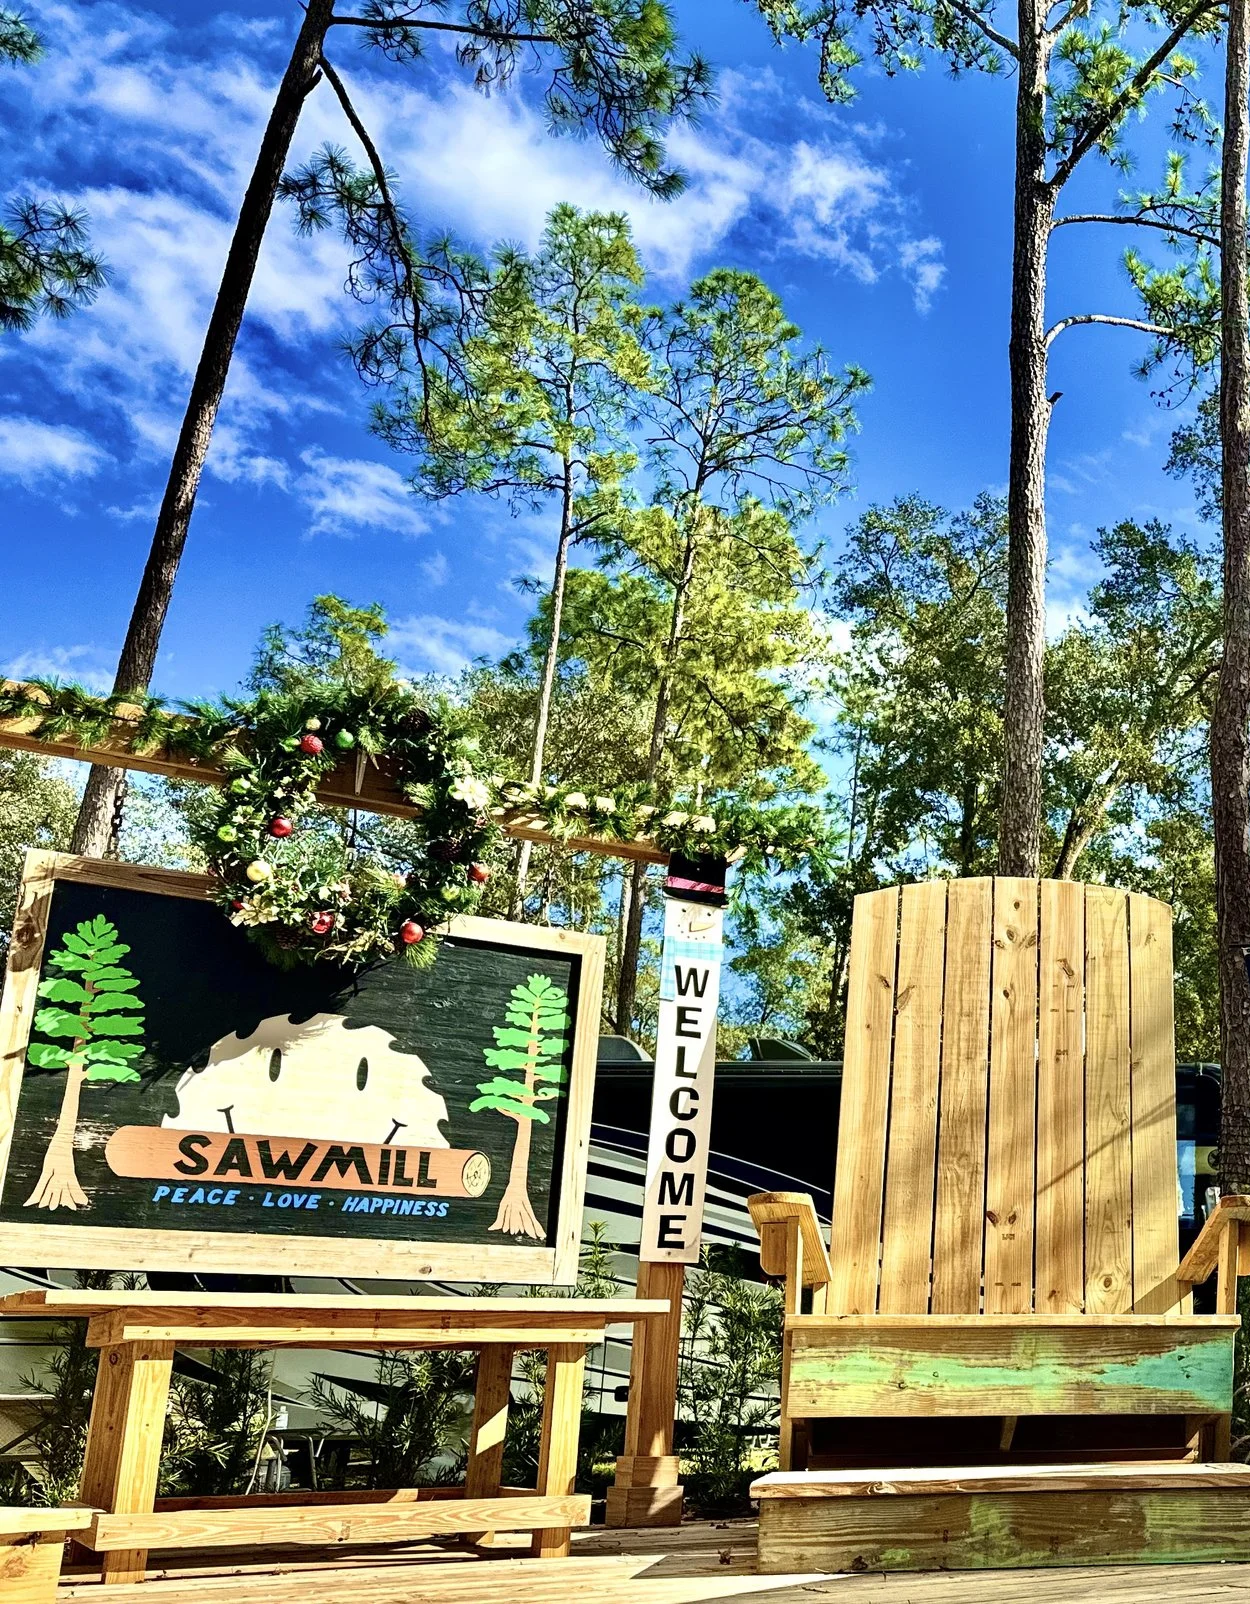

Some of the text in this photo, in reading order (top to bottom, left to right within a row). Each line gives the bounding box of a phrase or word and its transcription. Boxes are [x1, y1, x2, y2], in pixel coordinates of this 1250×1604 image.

[657, 964, 710, 1250] WELCOME
[173, 1134, 438, 1189] SAWMILL
[151, 1185, 450, 1218] PEACE LOVE HAPPINESS
